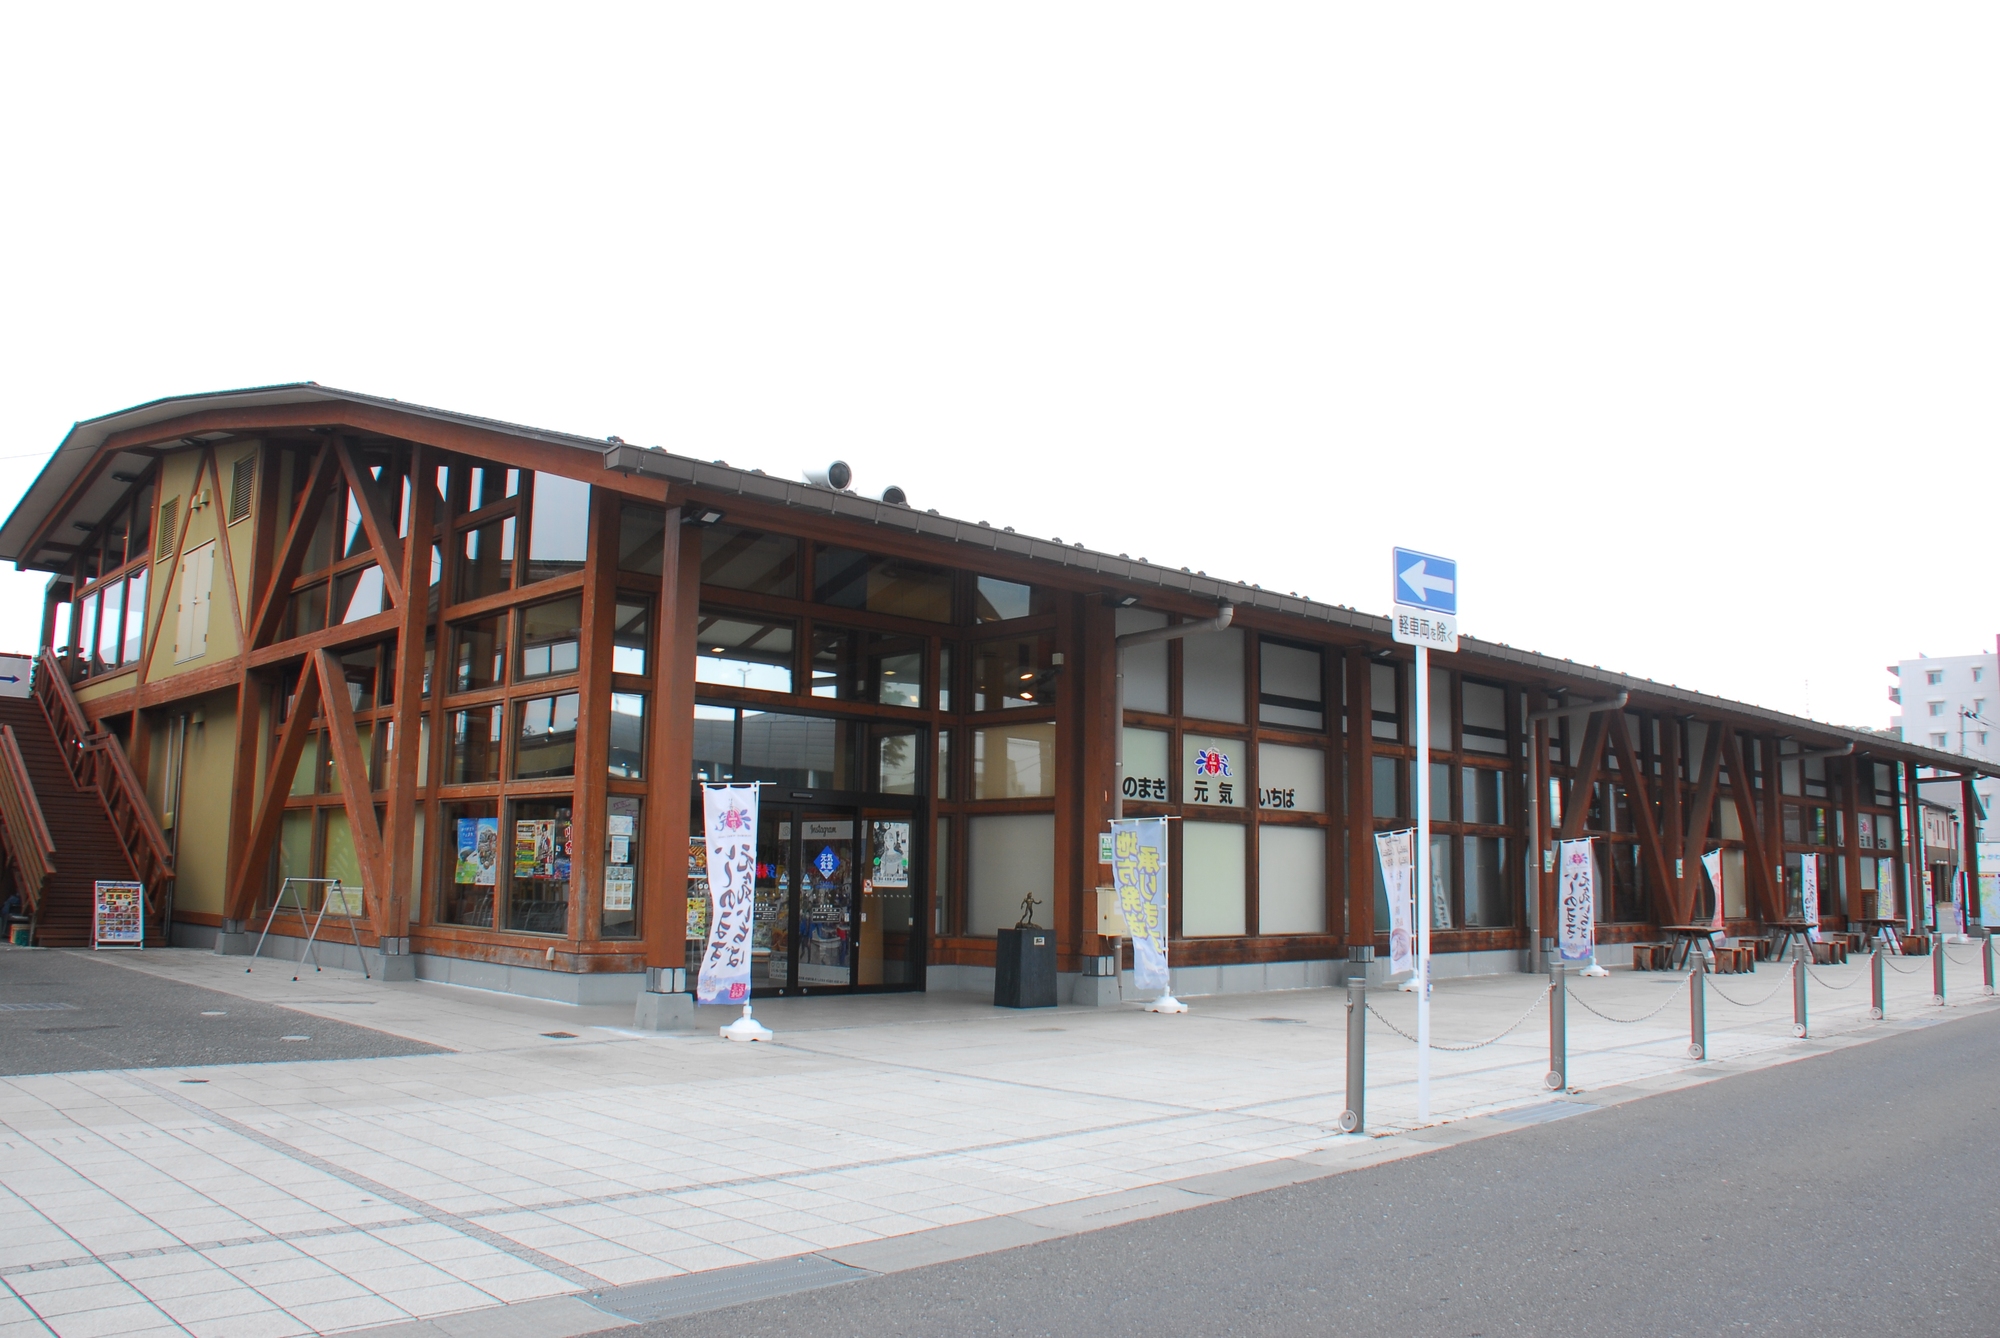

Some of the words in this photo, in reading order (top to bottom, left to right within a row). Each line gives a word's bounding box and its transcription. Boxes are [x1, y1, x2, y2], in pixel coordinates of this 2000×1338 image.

[1399, 614, 1453, 643] 軽車両を除く
[1122, 776, 1167, 800] のまき
[1194, 779, 1233, 804] 元気
[1259, 787, 1295, 808] いちば
[820, 854, 834, 863] 元気
[820, 862, 834, 871] 食堂
